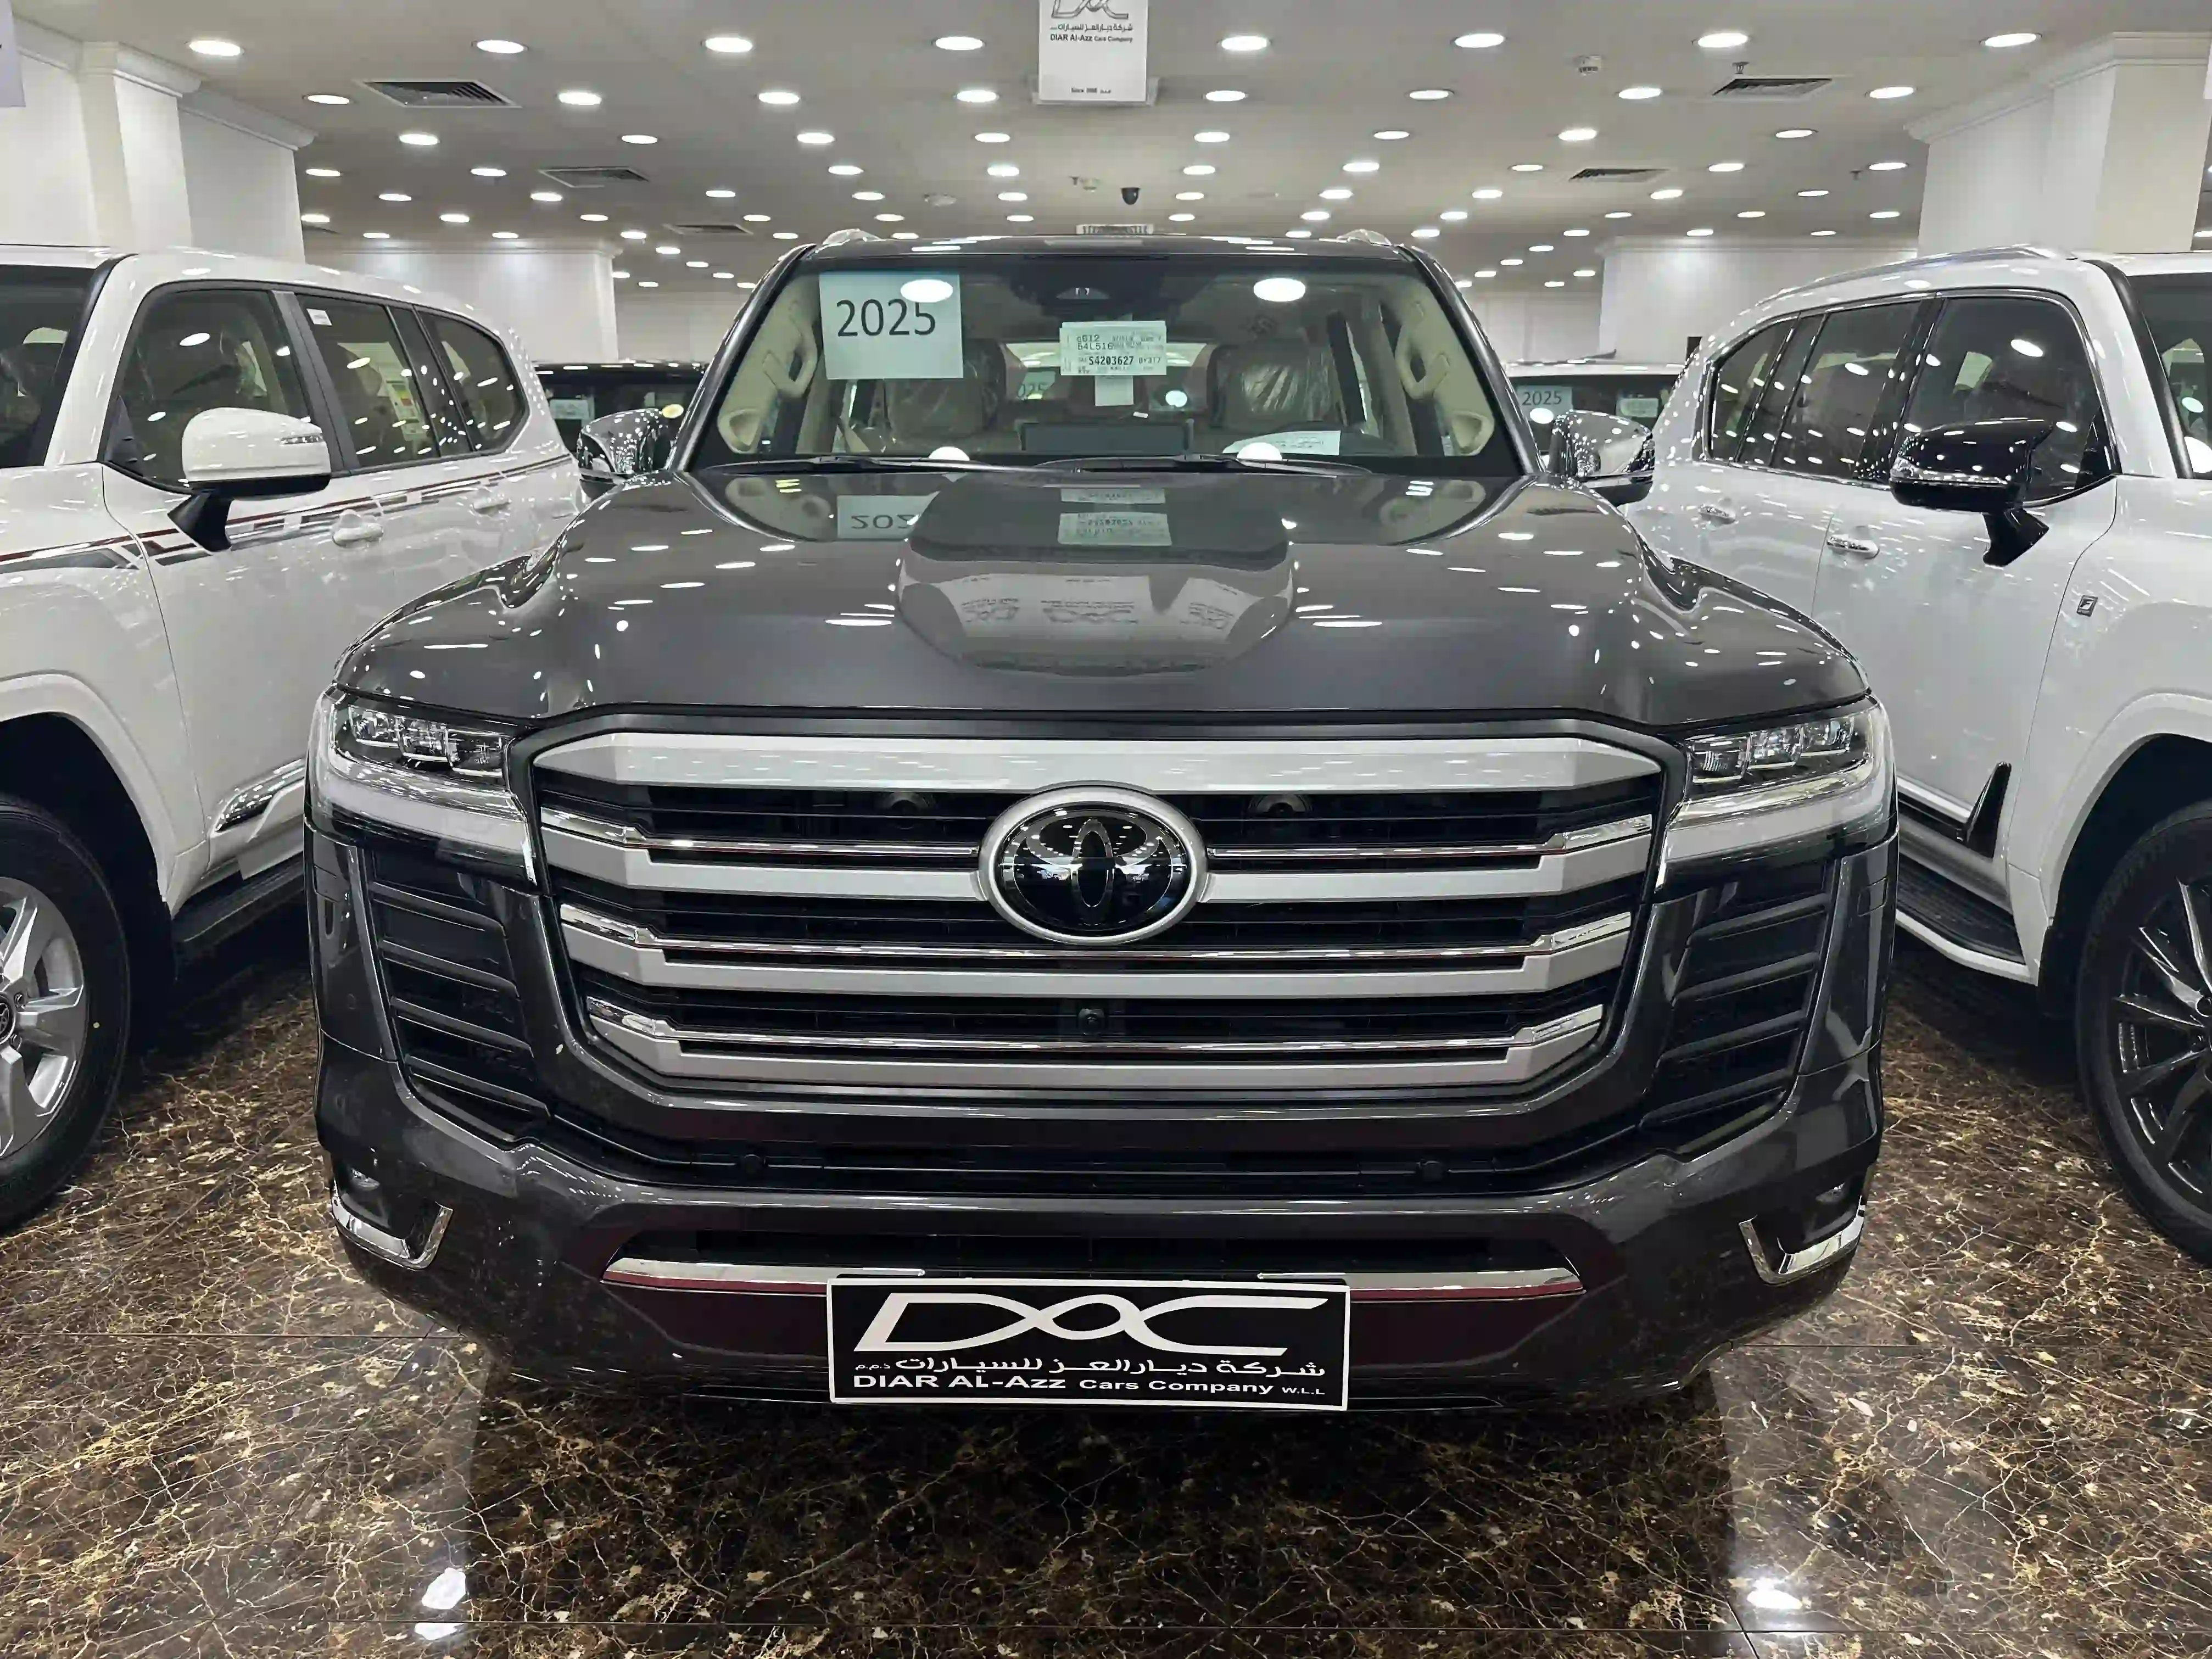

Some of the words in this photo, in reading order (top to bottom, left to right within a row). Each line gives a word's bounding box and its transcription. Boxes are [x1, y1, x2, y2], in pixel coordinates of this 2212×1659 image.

[836, 299, 936, 337] 2025
[1522, 390, 1562, 405] 2025
[895, 1358, 1042, 1373] للسيارات
[1215, 1360, 1325, 1377] شركة
[854, 1375, 940, 1388] DIAR
[1079, 1379, 1139, 1390] Cars
[1148, 1380, 1274, 1395] Company
